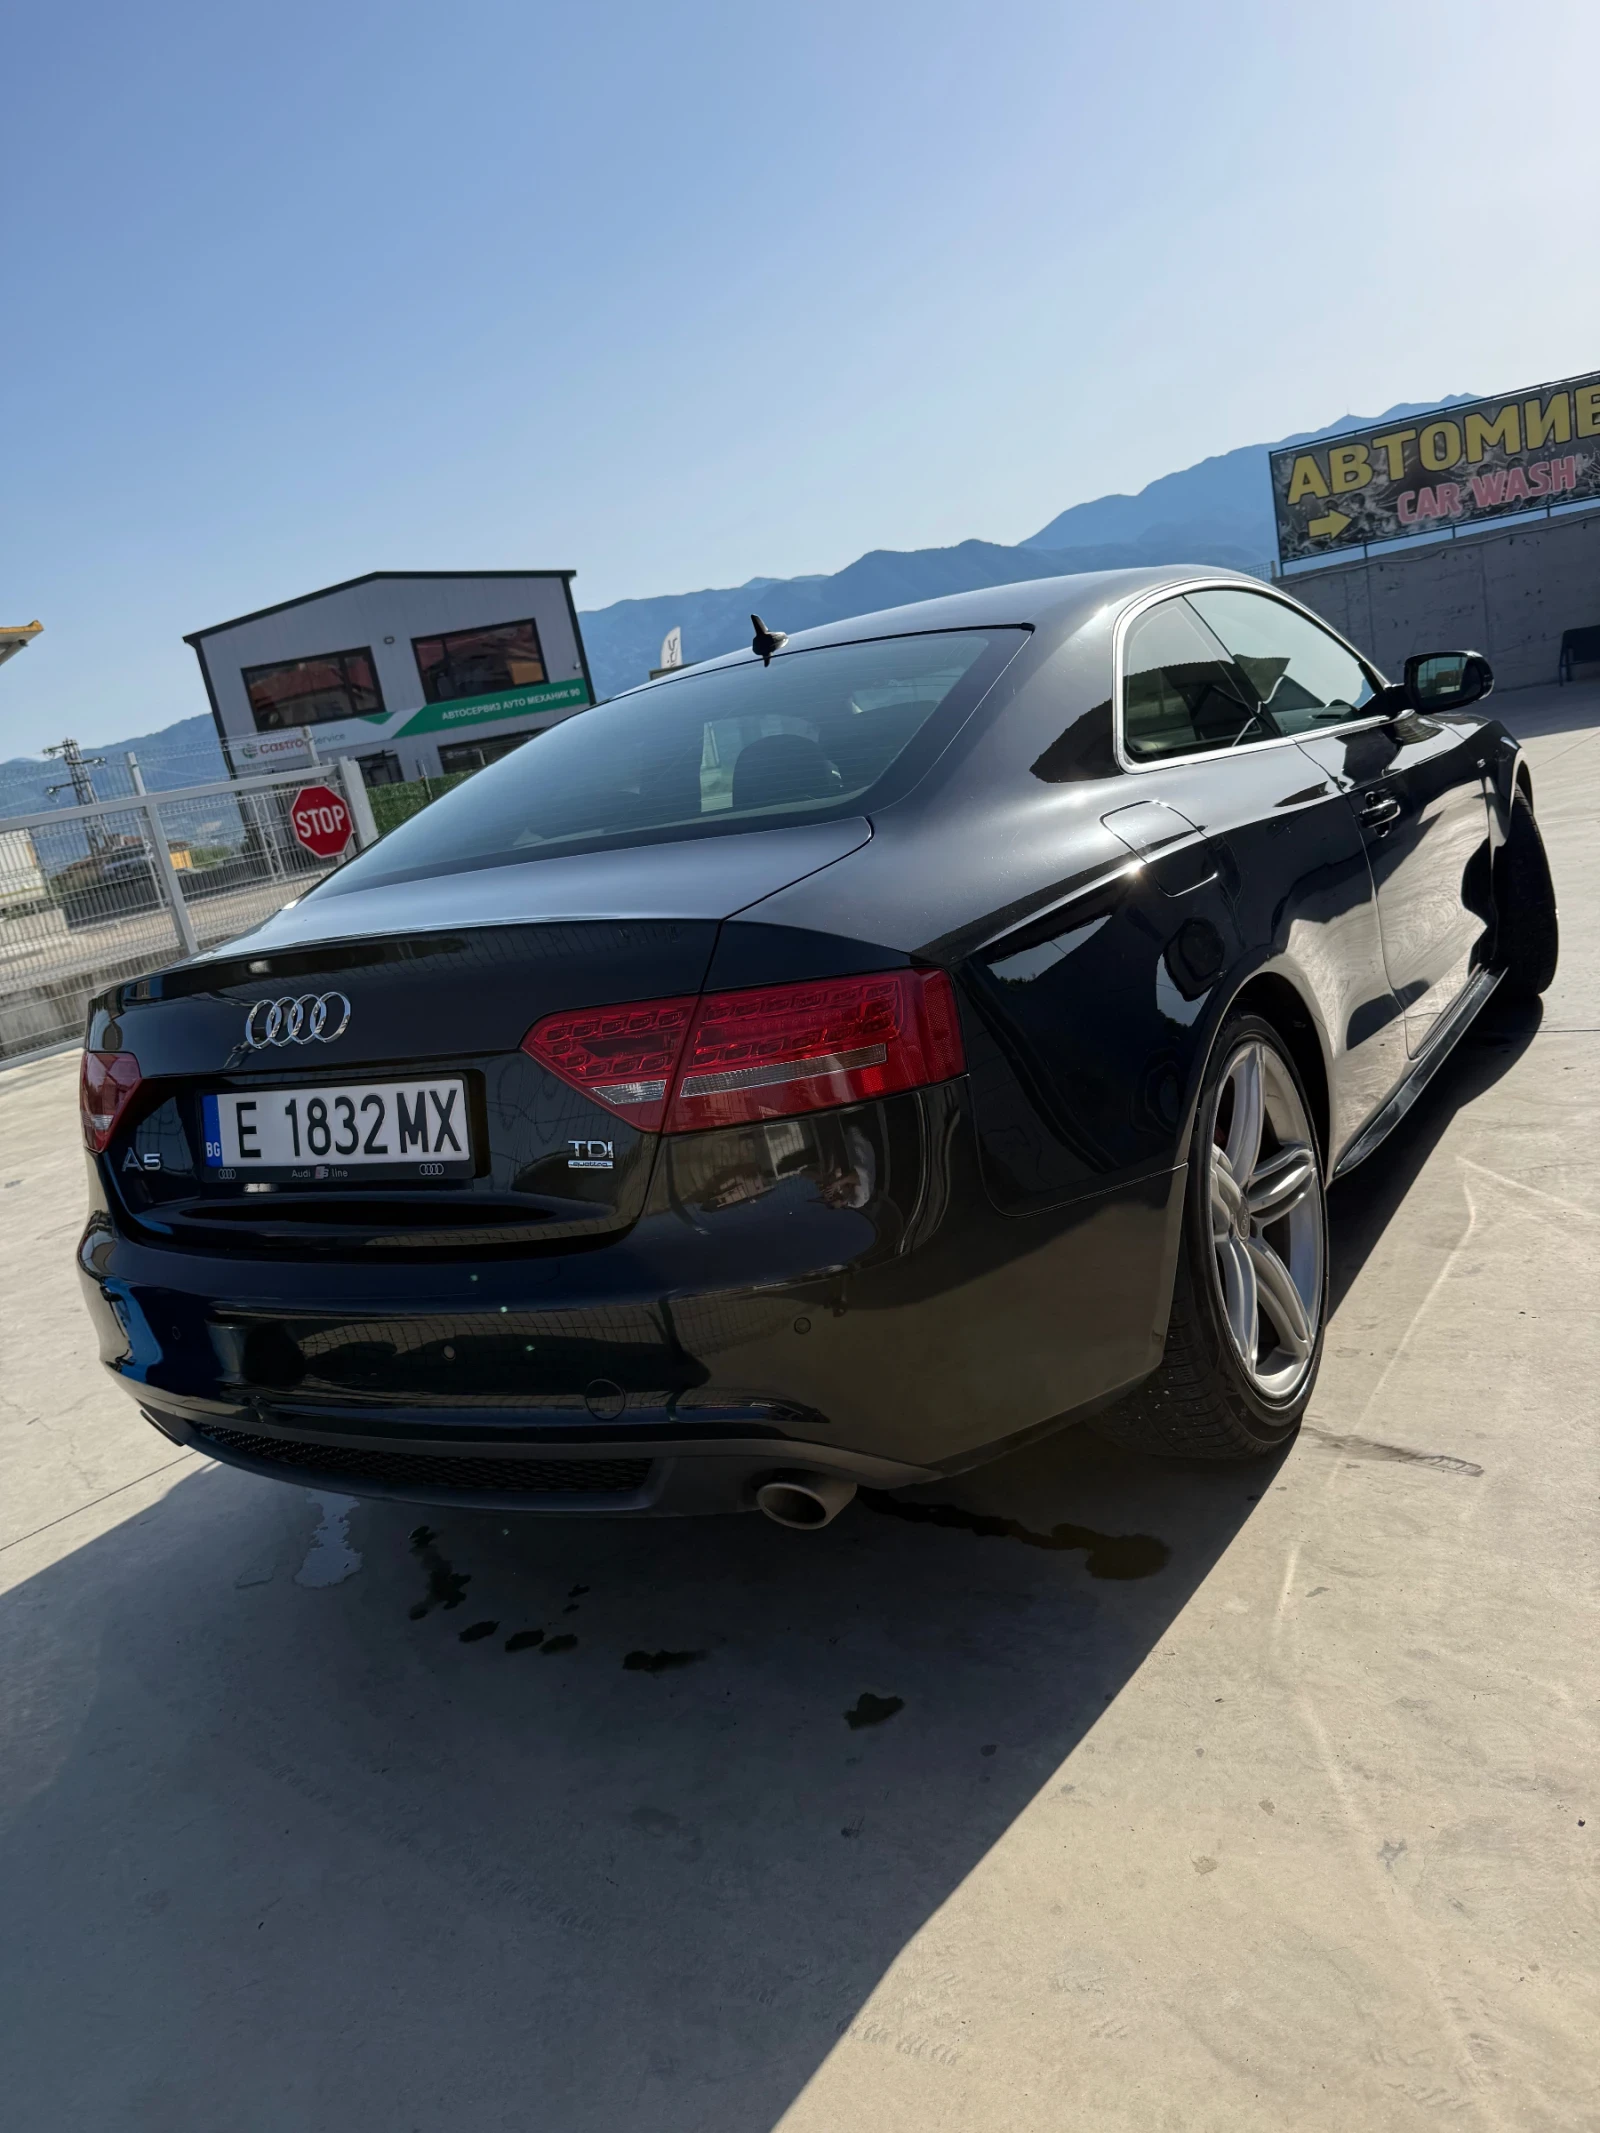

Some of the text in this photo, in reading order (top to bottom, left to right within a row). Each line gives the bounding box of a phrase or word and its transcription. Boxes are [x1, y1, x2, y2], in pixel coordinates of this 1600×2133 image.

[1396, 456, 1576, 524] CAR WASH
[442, 702, 502, 720] АВТОСЕРВИЗ
[503, 698, 525, 711] АУТО
[527, 690, 569, 705] МЕХАНИК
[260, 736, 306, 754] Castro
[296, 805, 345, 839] STOP
[236, 1089, 462, 1158] E 1832 MX
[121, 1147, 161, 1172] A5
[206, 1141, 221, 1158] BG
[568, 1140, 614, 1159] TDI
[291, 1168, 311, 1178] Audi
[331, 1167, 349, 1178] line
